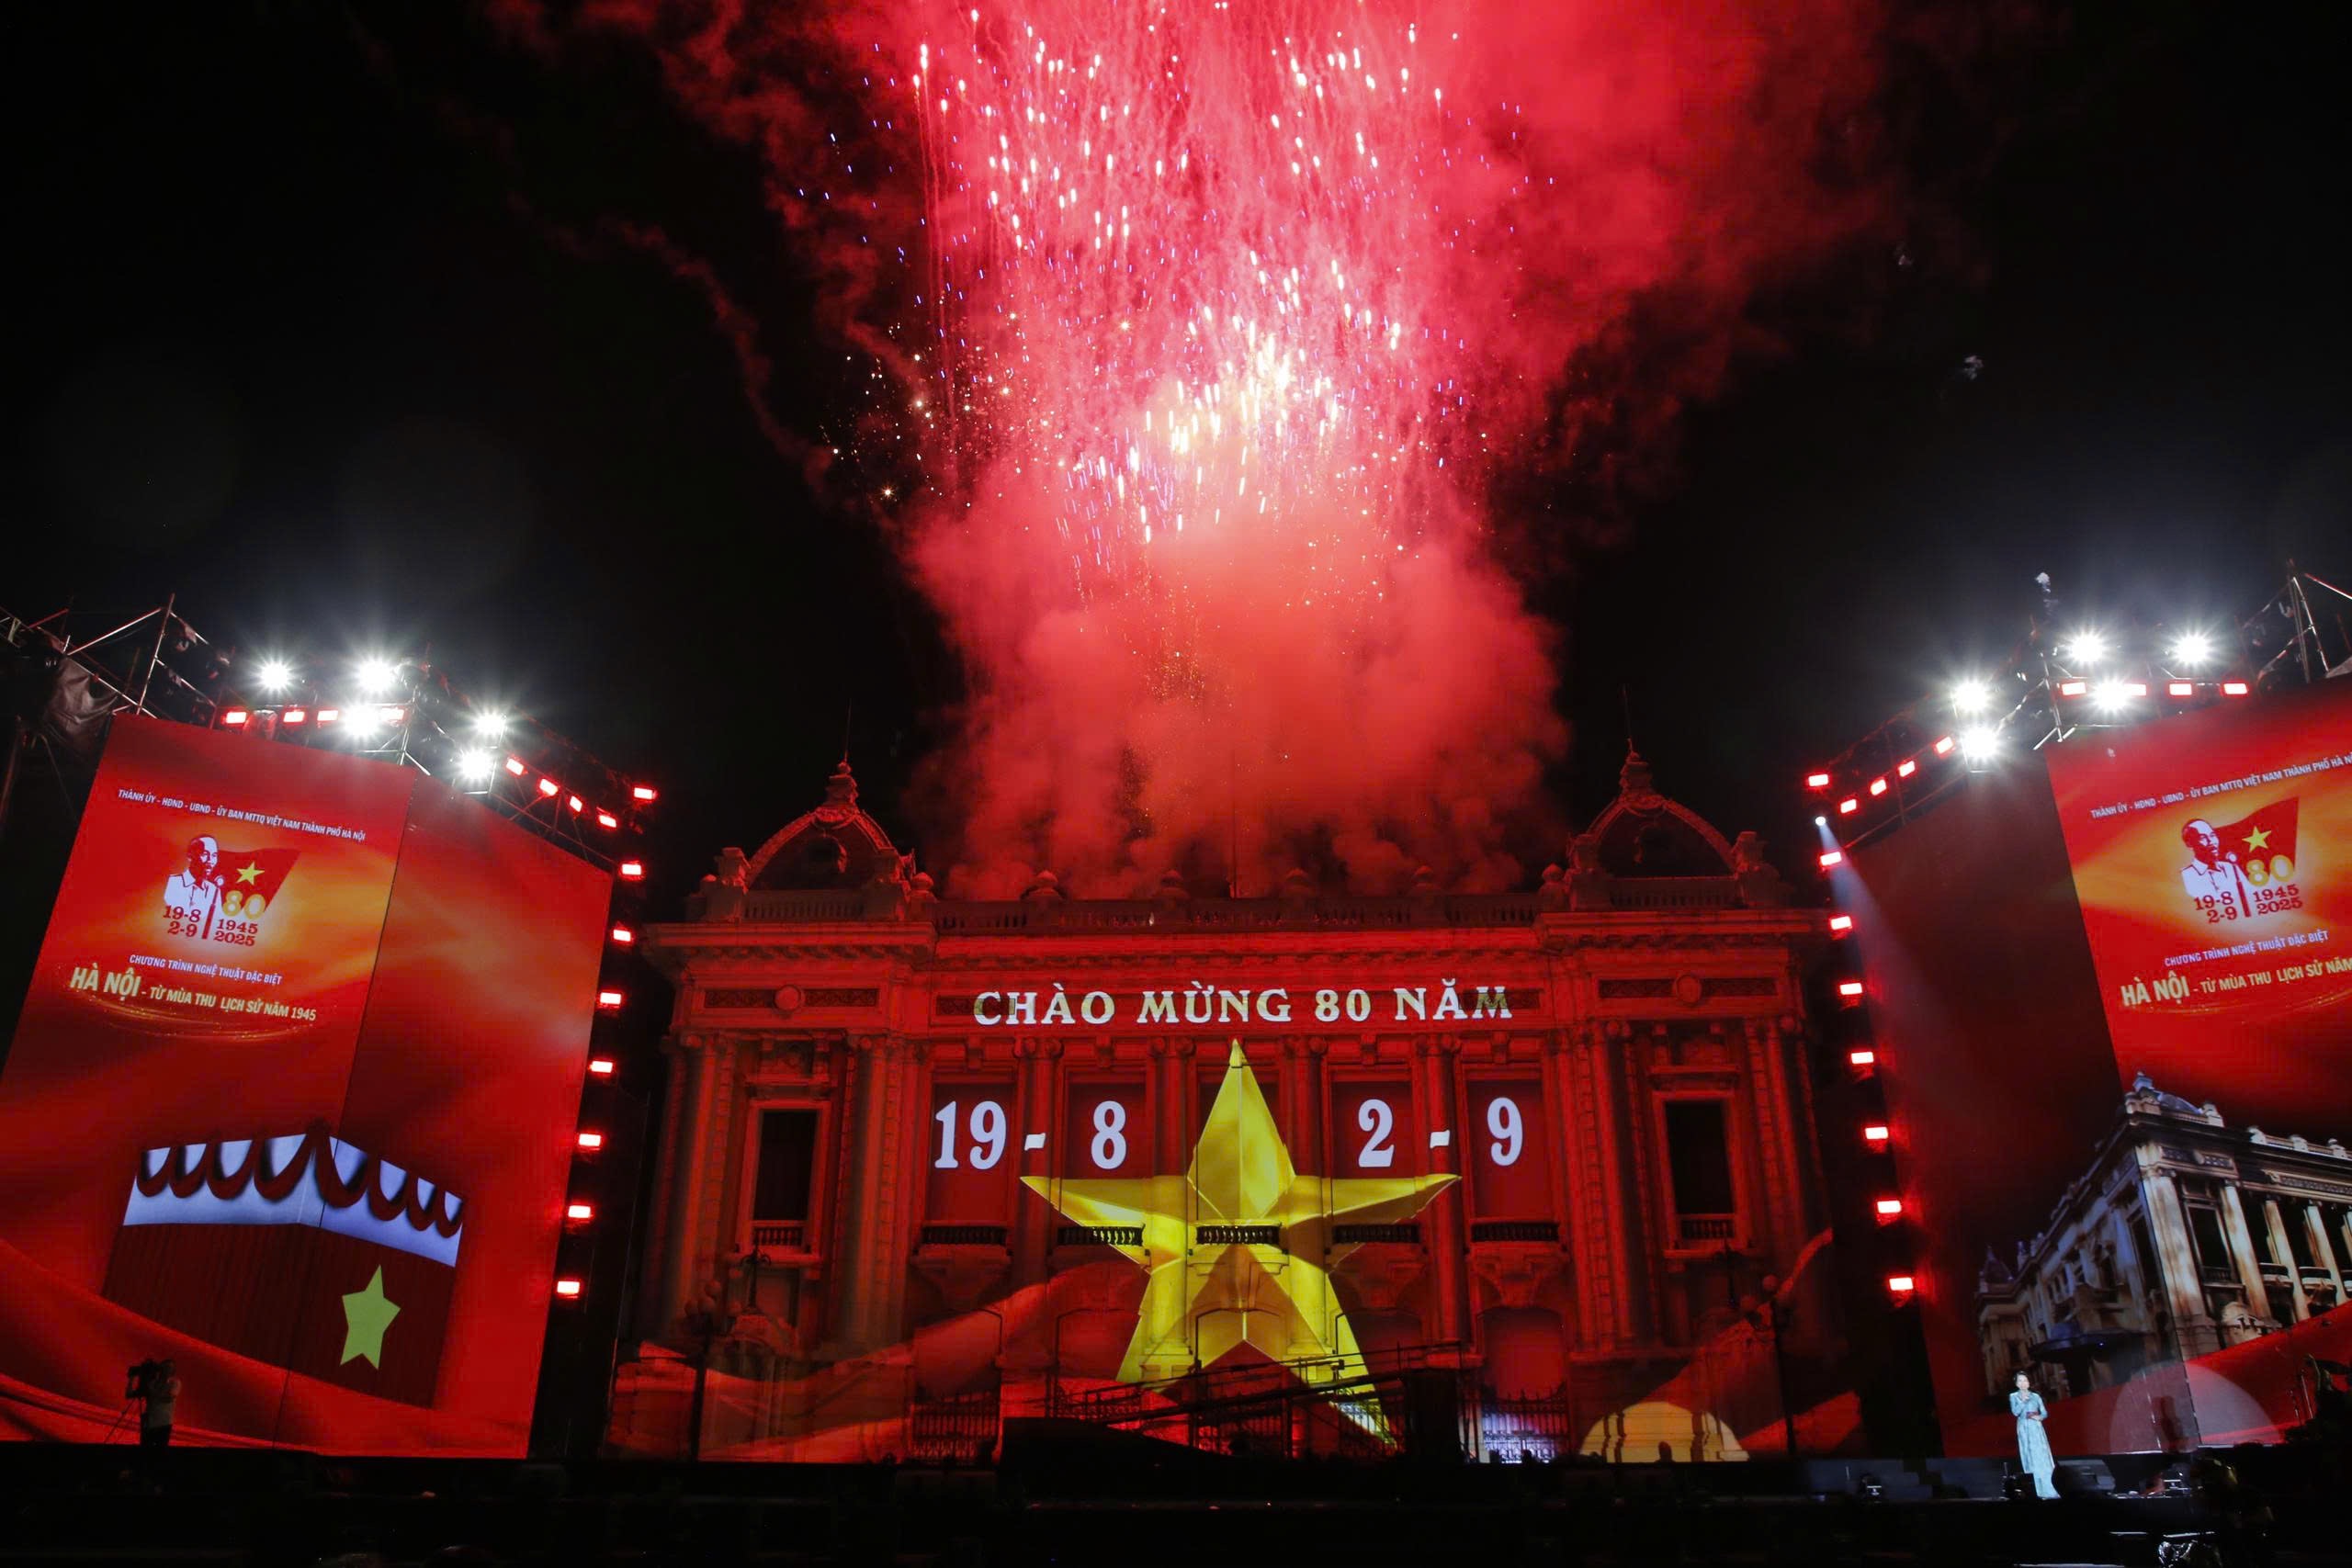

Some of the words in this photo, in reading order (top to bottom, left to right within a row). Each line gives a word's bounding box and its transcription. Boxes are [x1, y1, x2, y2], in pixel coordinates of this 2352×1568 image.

[162, 797, 183, 808] HĐND
[189, 802, 210, 814] UBND
[227, 809, 243, 820] BAN
[244, 812, 266, 825] MTTQ
[266, 815, 283, 827] VIỆT
[283, 818, 300, 829] NAM
[301, 821, 326, 835] THÀNH
[325, 825, 341, 837] PHỐ
[341, 828, 351, 839] HÀ
[352, 829, 366, 842] NỘI
[2246, 854, 2294, 886] 80
[222, 890, 266, 919] 80
[2194, 891, 2233, 910] 19-8
[2253, 884, 2299, 902] 1945
[2256, 897, 2303, 915] 2025
[163, 905, 201, 923] 19-8
[167, 920, 198, 937] 2-9
[216, 919, 258, 934] 1945
[2207, 906, 2237, 924] 2-9
[213, 930, 256, 947] 2025
[2165, 953, 2201, 967] CHƯƠNG
[2202, 947, 2230, 960] TRÌNH
[2231, 942, 2256, 955] NGHỆ
[2256, 936, 2286, 951] THUẬT
[2288, 933, 2306, 947] ĐẶC
[2308, 929, 2329, 943] BIỆT
[129, 954, 165, 968] CHƯƠNG
[168, 959, 193, 972] TRÌNH
[195, 964, 218, 978] NGHỆ
[219, 967, 245, 981] THUẬT
[245, 971, 263, 984] ĐẶC
[264, 974, 283, 986] BIỆT
[2120, 976, 2152, 1006] HÀ
[2153, 970, 2190, 1005] NỘI
[2200, 977, 2216, 993] TỪ
[2219, 973, 2247, 990] MÙA
[2247, 971, 2271, 986] THU
[2277, 965, 2304, 984] LỊCH
[2305, 959, 2323, 977] SỬ
[70, 962, 99, 991] HÀ
[103, 967, 141, 1001] NỘI
[150, 985, 166, 1000] TỪ
[166, 987, 192, 1004] MÙA
[195, 993, 217, 1008] THU
[220, 997, 244, 1012] LỊCH
[246, 998, 264, 1014] SỬ
[264, 1001, 289, 1017] NĂM
[290, 1007, 316, 1021] 1945
[974, 983, 1114, 1025] CHÀO
[1136, 980, 1292, 1023] MỪNG
[1315, 988, 1371, 1021] 80
[1394, 977, 1512, 1021] NĂM
[934, 1100, 1007, 1169] 19
[1091, 1100, 1126, 1169] 8
[1358, 1099, 1395, 1168] 2
[1487, 1097, 1523, 1166] 9
